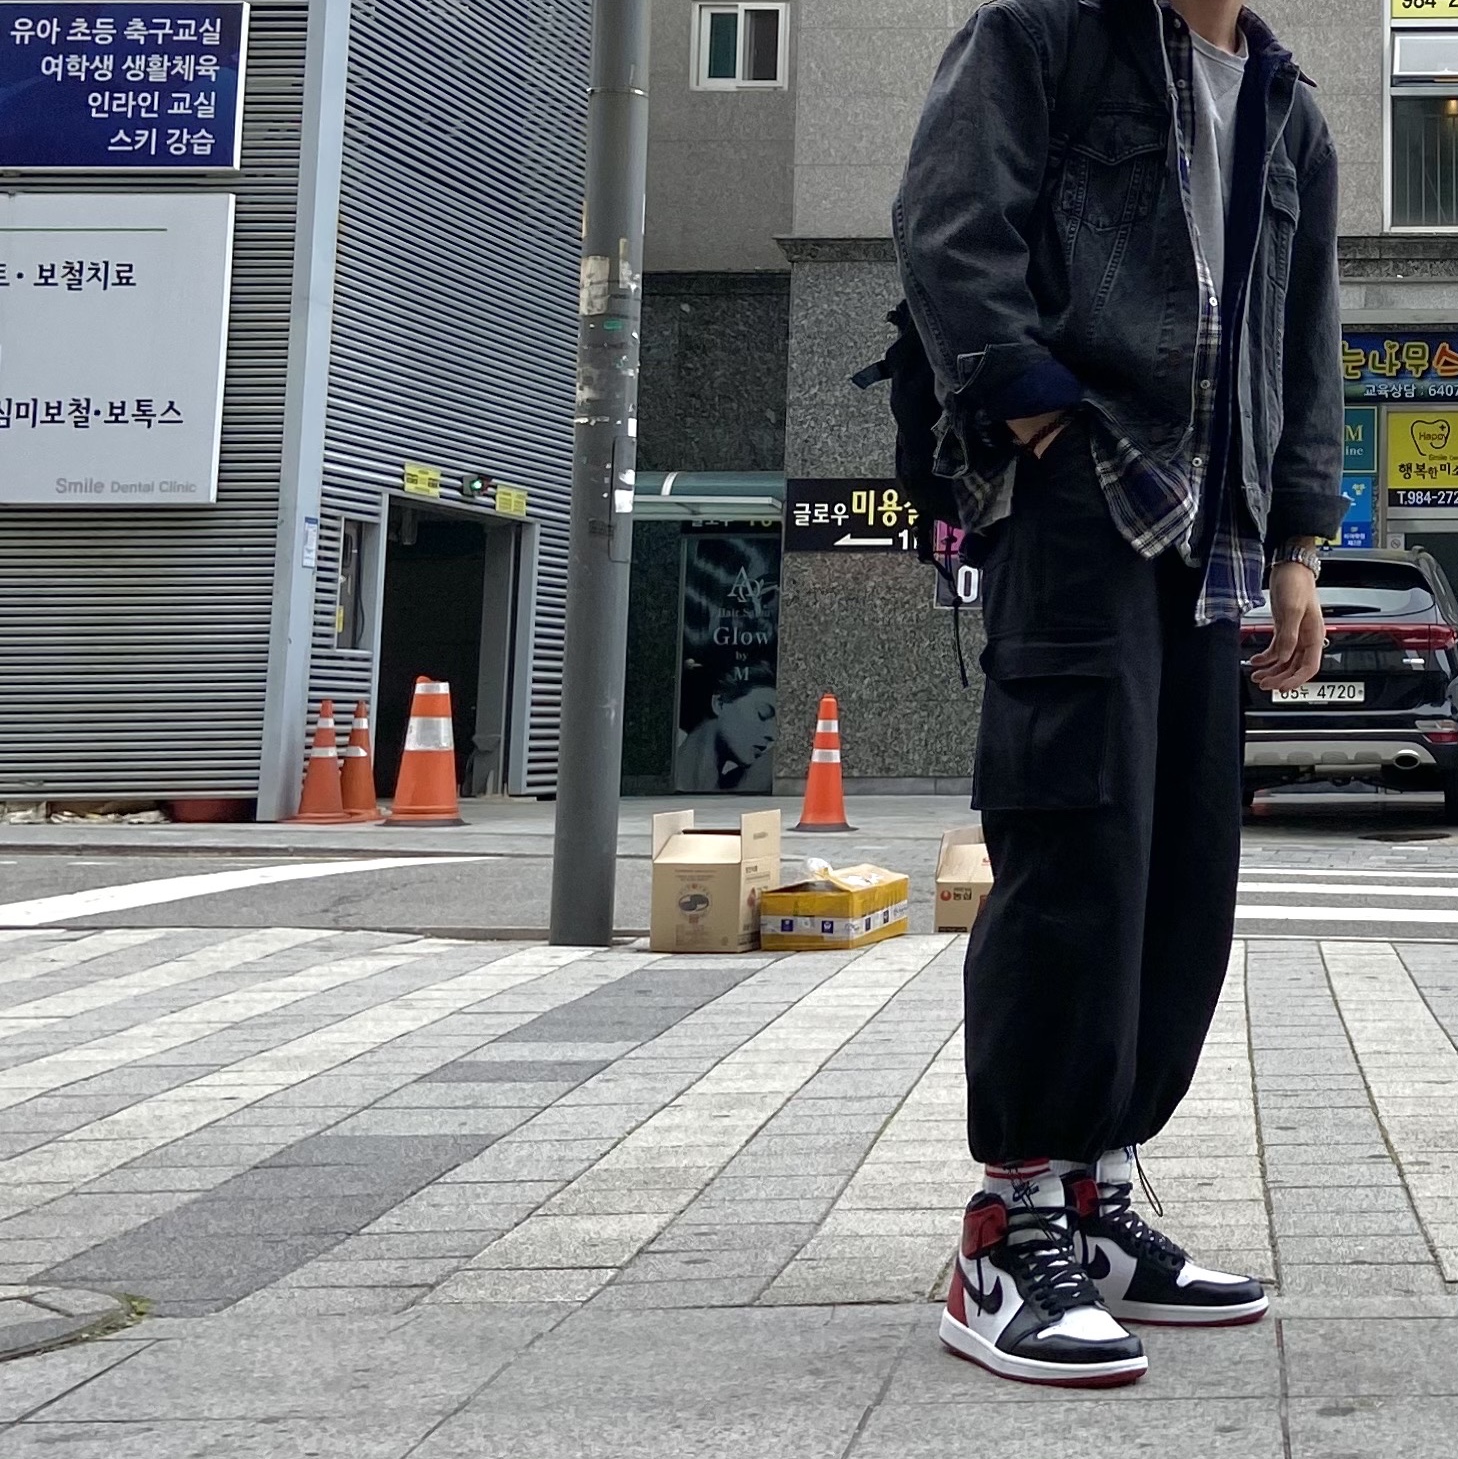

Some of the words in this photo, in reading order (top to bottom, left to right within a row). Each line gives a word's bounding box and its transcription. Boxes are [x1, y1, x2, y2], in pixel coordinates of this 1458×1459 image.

[10, 18, 61, 44] 유아
[66, 18, 117, 44] 초등
[123, 18, 221, 45] 축구교실
[40, 54, 114, 81] 여학생
[121, 54, 220, 82] 생활체육
[88, 91, 159, 118] 인라인
[167, 91, 216, 118] 교실
[108, 128, 157, 155] 스키
[166, 128, 216, 155] 강습
[55, 477, 104, 494] Smile
[110, 480, 154, 493] Dental
[159, 480, 196, 493] Clinic
[793, 503, 849, 526] 글로우
[713, 626, 769, 645] Glow
[1317, 685, 1356, 699] 4720
